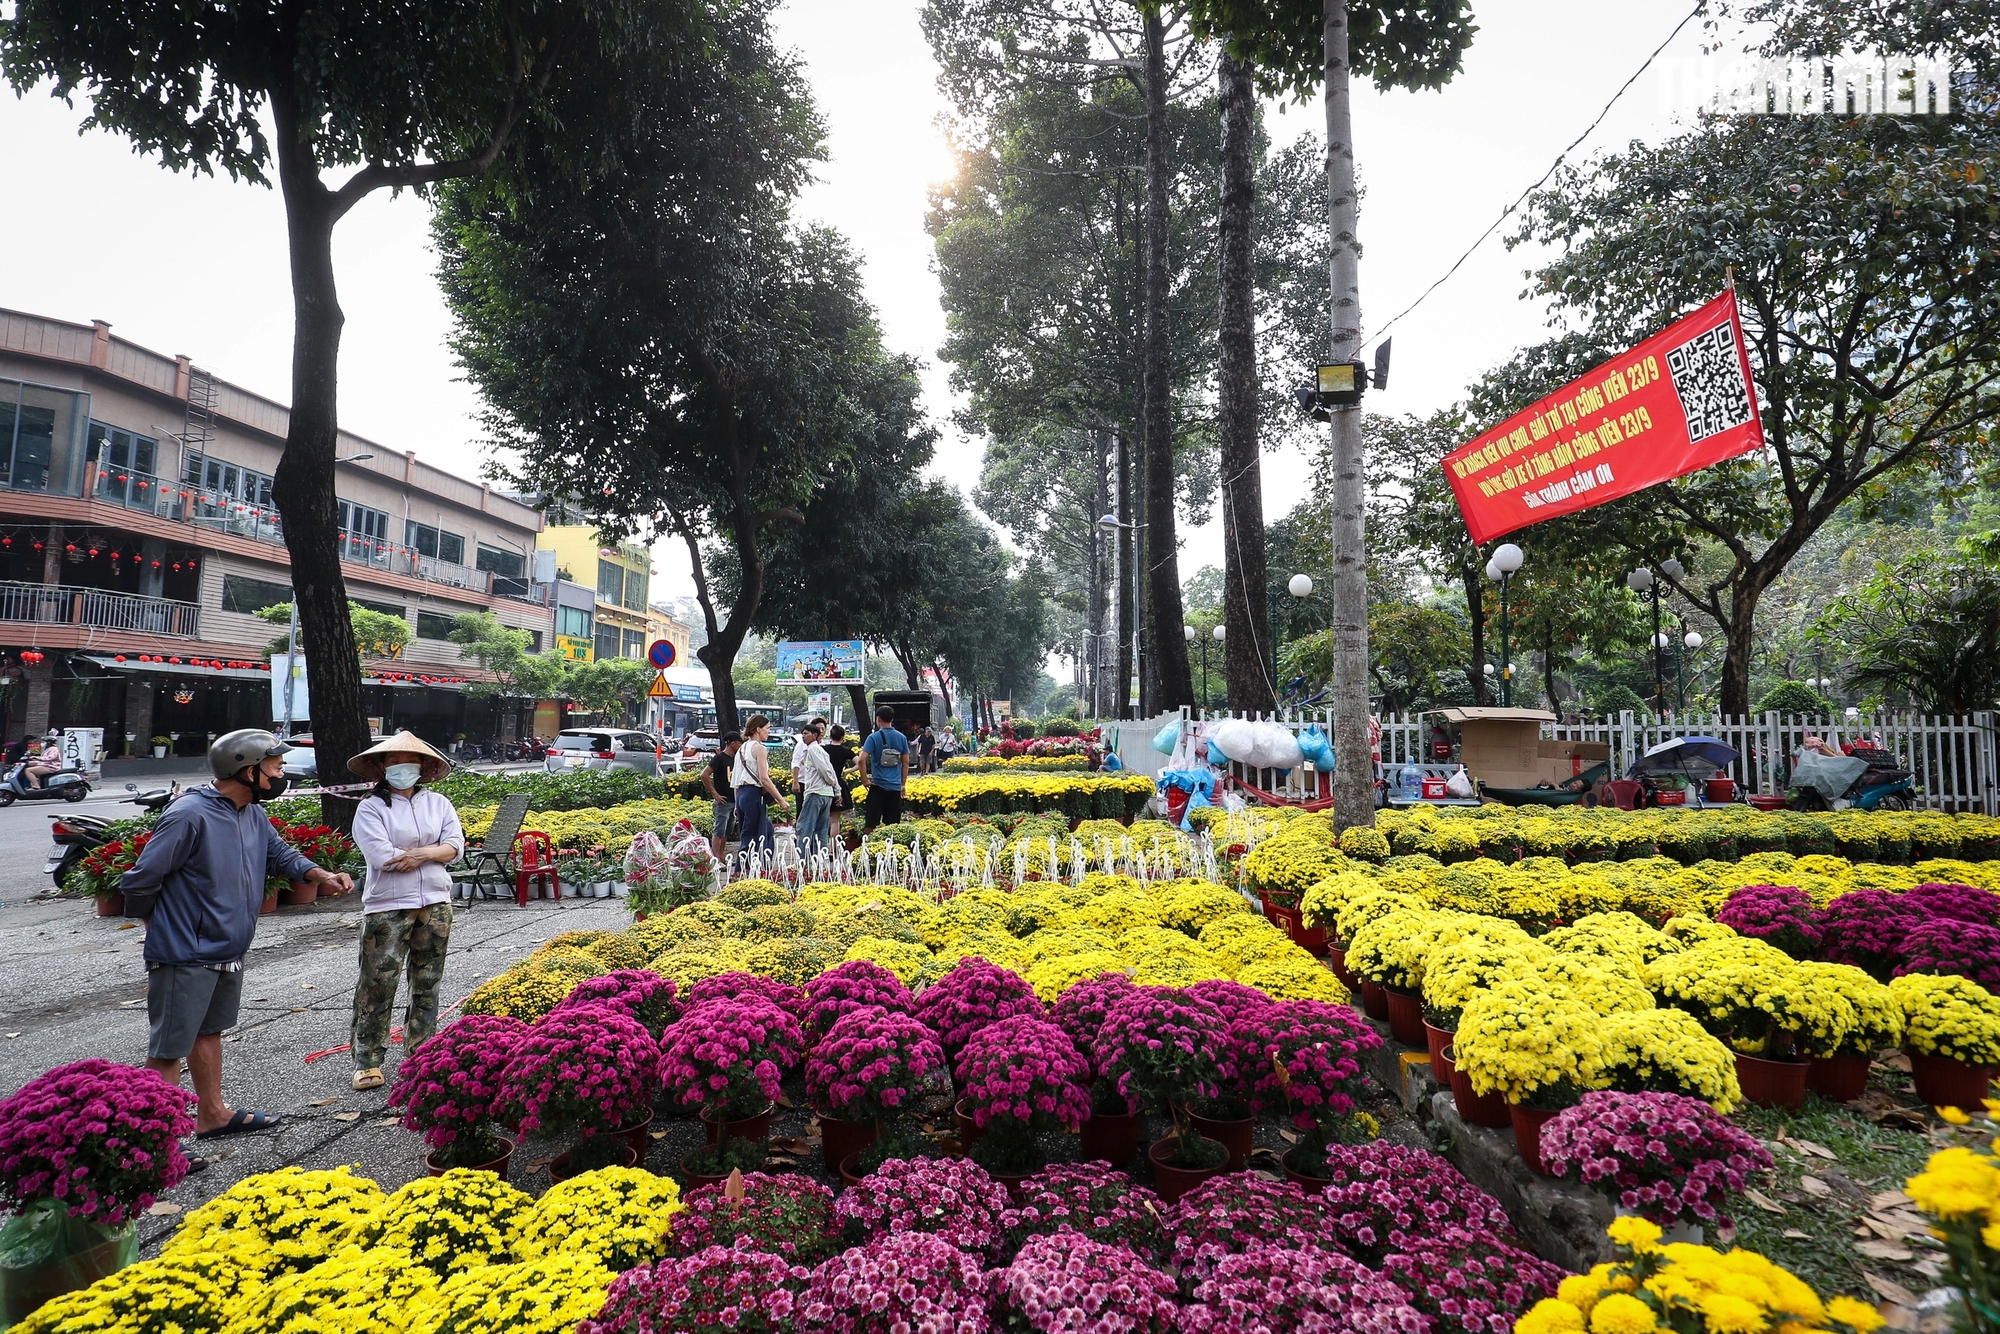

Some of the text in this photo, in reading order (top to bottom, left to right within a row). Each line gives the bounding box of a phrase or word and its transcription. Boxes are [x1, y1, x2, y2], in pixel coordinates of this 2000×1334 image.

[1462, 451, 1489, 474] KHÁCH
[1483, 440, 1501, 464] ĐẾN
[1496, 436, 1513, 458] VUI
[1510, 425, 1534, 451] CHƠI,
[1529, 411, 1549, 441] GIẢI
[1545, 402, 1563, 432] TRÍ
[1560, 400, 1578, 427] TẠI
[1575, 386, 1605, 417] CÔNG
[1601, 370, 1629, 403] VIÊN
[1627, 355, 1660, 392] 23/9
[1514, 464, 1529, 486] XE
[1522, 455, 1535, 480] Ở
[1530, 452, 1556, 478] TẦNG
[1551, 441, 1576, 468] HẦM
[1571, 430, 1601, 460] CÔNG
[1595, 416, 1624, 448] VIÊN
[1620, 405, 1653, 439] 23/9
[1538, 482, 1573, 504] THÀNH
[1570, 470, 1598, 494] CÁM
[1595, 462, 1615, 485] ƠN
